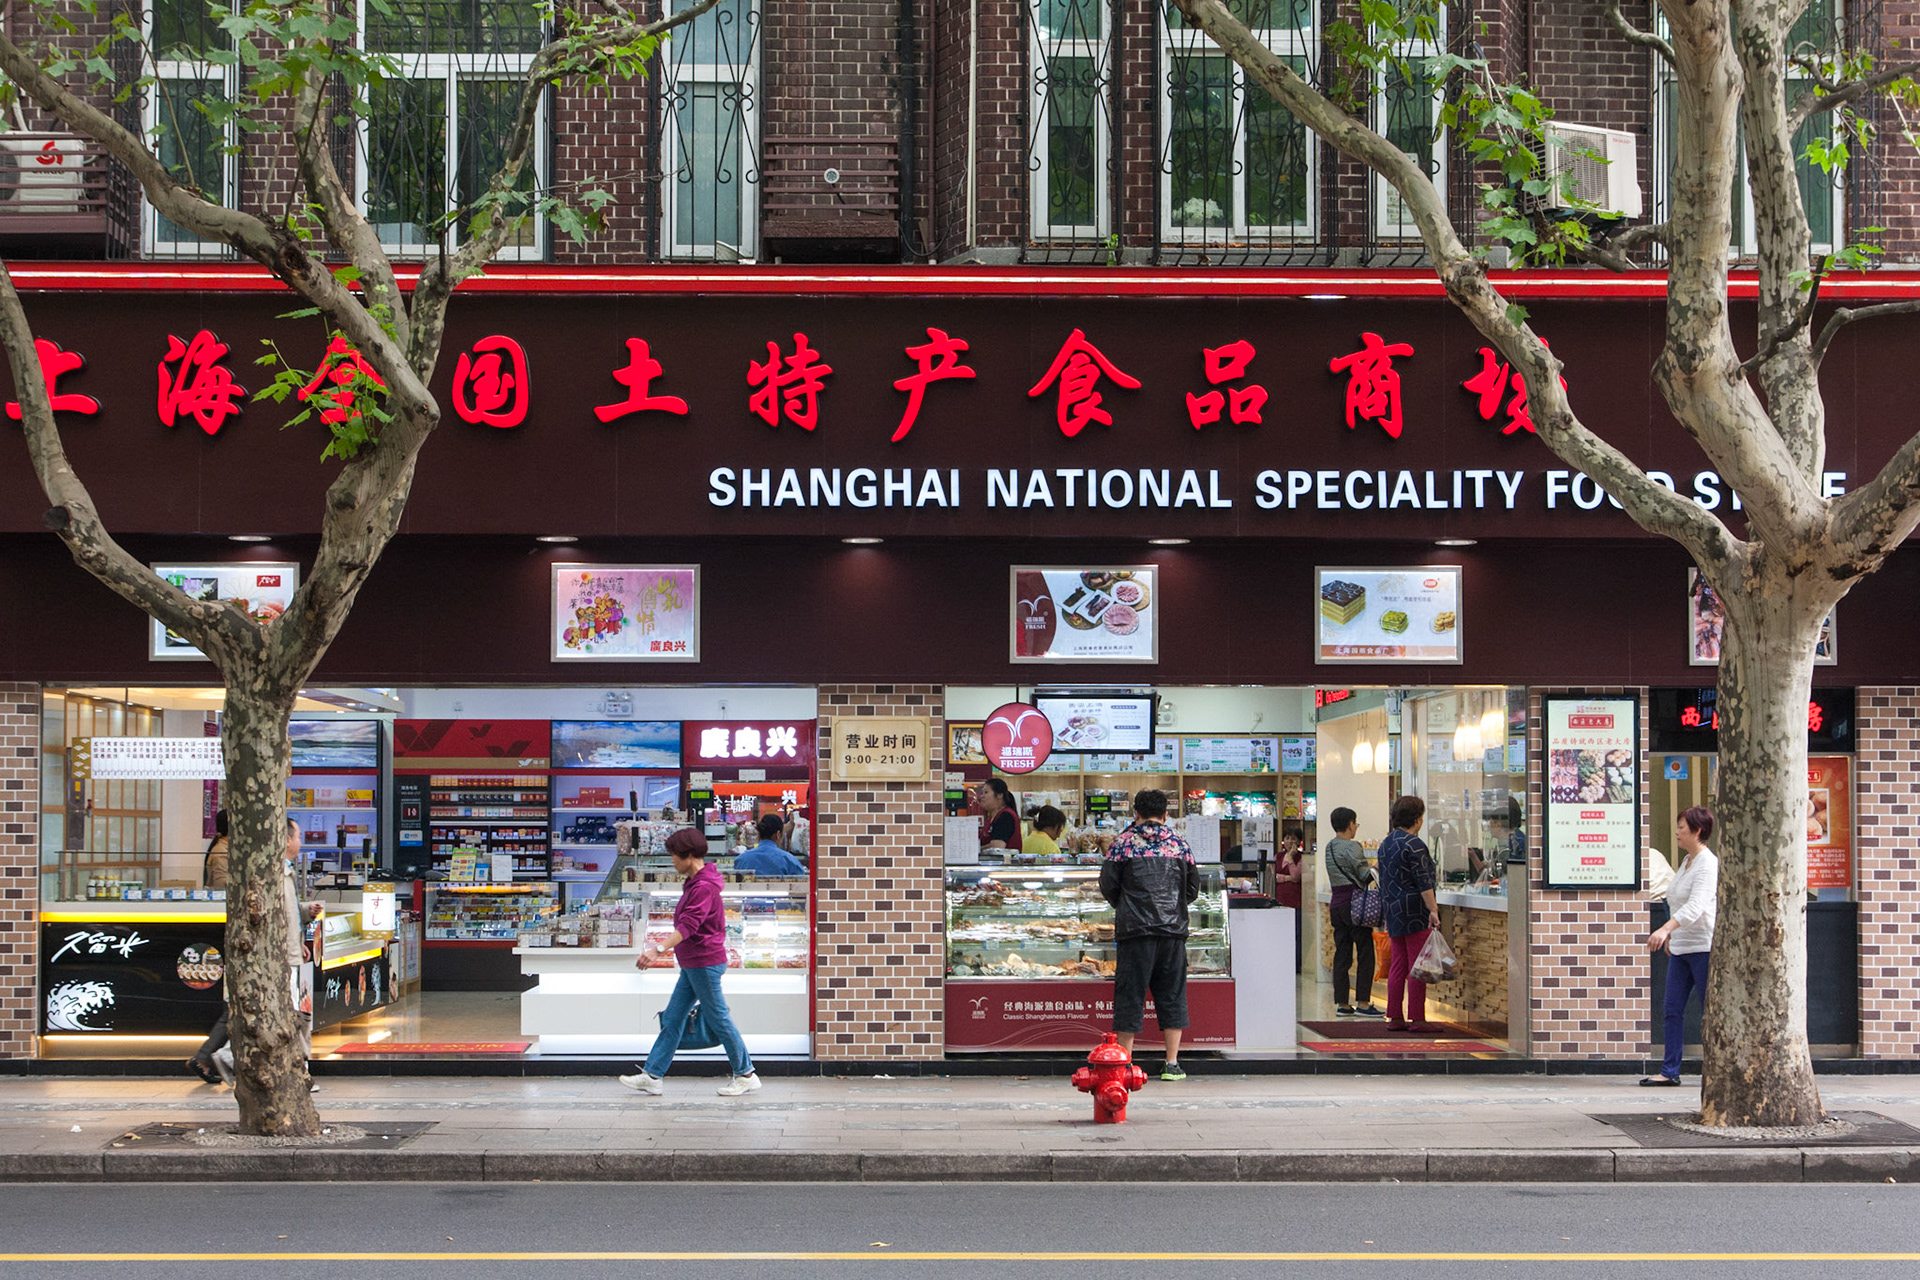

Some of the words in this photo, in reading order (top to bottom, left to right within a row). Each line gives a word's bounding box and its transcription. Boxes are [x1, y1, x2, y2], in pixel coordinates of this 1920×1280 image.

[709, 467, 960, 508] SHANGHAI
[987, 468, 1232, 508] NATIONAL
[1256, 469, 1525, 509] SPECIALITY
[846, 734, 916, 749] 营业时间
[1000, 759, 1035, 769] FRESH
[371, 895, 384, 927] すし
[1025, 1013, 1066, 1021] Shanghainess
